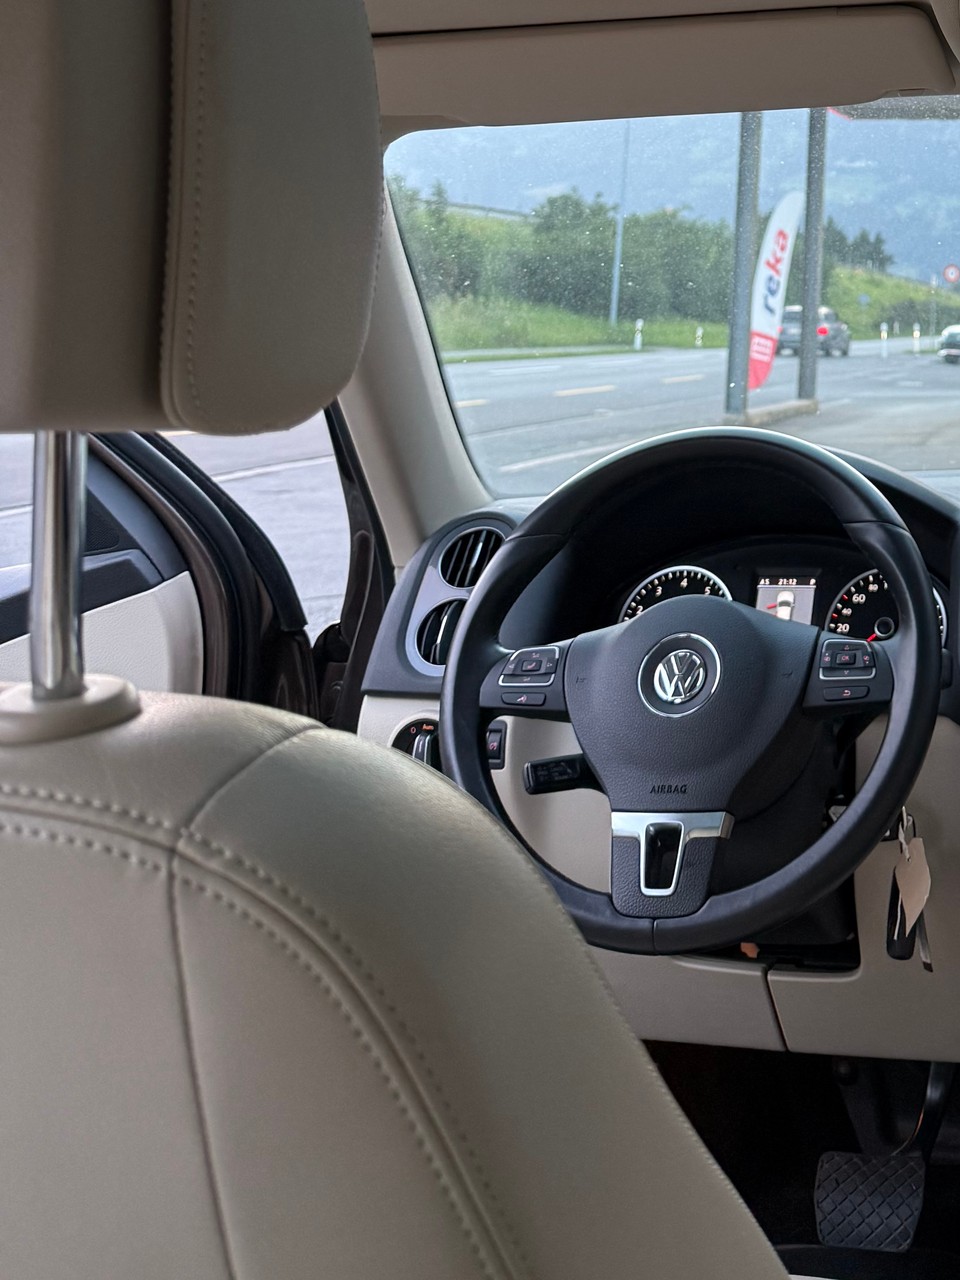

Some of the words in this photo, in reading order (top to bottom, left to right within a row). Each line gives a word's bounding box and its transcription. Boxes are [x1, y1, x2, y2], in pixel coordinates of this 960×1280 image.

[763, 229, 789, 315] reka
[680, 578, 688, 589] 4
[655, 586, 663, 598] 3
[704, 586, 711, 596] 5
[852, 593, 866, 604] 60
[841, 607, 852, 617] 40
[836, 623, 850, 634] 20
[650, 784, 688, 795] AIRBAG
